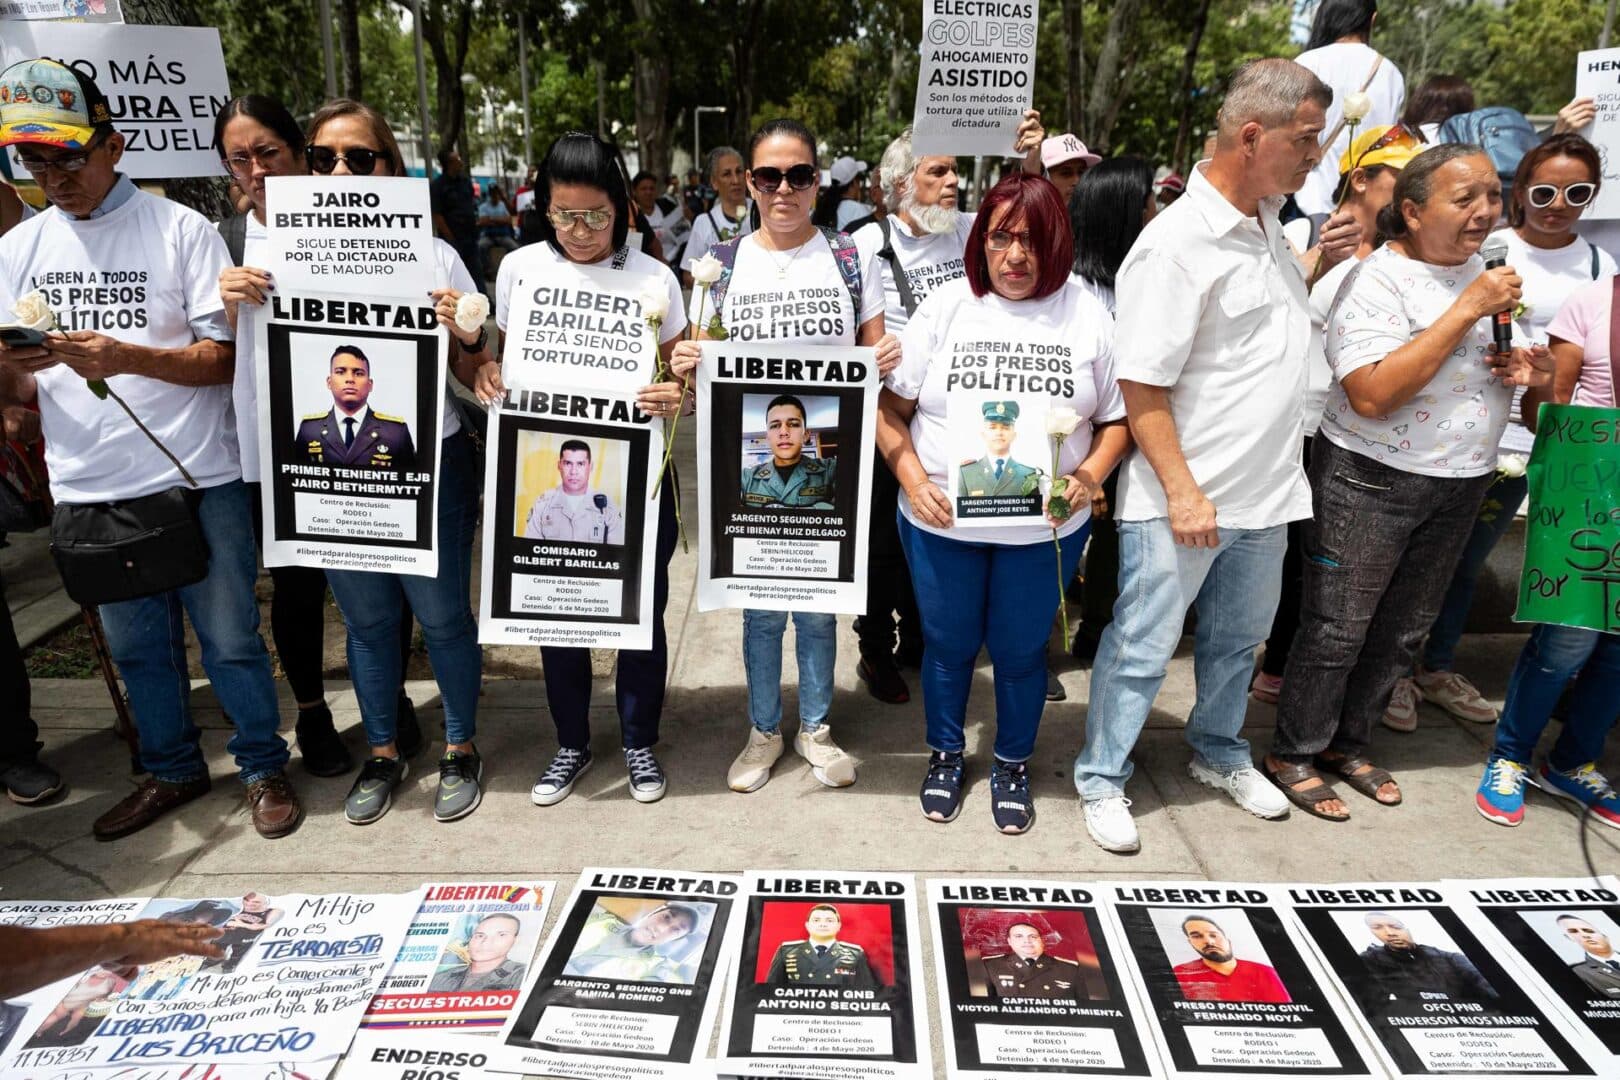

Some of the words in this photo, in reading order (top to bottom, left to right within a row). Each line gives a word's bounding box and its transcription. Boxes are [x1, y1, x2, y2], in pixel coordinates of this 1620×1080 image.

[927, 19, 1035, 48] GOLPES
[931, 50, 1029, 64] AHOGAMIENTO
[108, 54, 187, 85] MÁS
[928, 68, 1028, 88] ASISTIDO
[929, 92, 950, 102] Son
[952, 92, 967, 102] los
[970, 92, 1014, 104] métodos
[1016, 94, 1027, 103] de
[926, 106, 962, 116] tortura
[965, 108, 984, 120] que
[987, 106, 1018, 116] utiliza
[952, 119, 1000, 128] dictadura
[312, 192, 380, 208] JAIRO
[275, 212, 423, 229] BETHERMYTT
[296, 238, 337, 249] SIGUE
[340, 239, 411, 250] DETENIDO
[285, 252, 314, 262] POR
[317, 252, 334, 262] LA
[337, 252, 418, 263] DICTADURA
[88, 271, 97, 284] A
[101, 270, 148, 285] TODOS
[310, 264, 329, 275] DE
[332, 264, 394, 275] MADURO
[69, 286, 146, 306] PRESOS
[732, 292, 783, 306] LIBEREN
[787, 291, 796, 301] A
[798, 287, 840, 299] TODOS
[272, 296, 439, 331] LIBERTAD
[732, 306, 764, 323] LOS
[770, 300, 842, 320] PRESOS
[528, 310, 644, 339] BARILLAS
[730, 317, 844, 342] POLÍTICOS
[524, 329, 568, 345] ESTÁ
[573, 334, 643, 354] SIENDO
[954, 341, 1010, 354] LIBEREN
[1014, 342, 1024, 354] A
[1028, 344, 1072, 358] TODOS
[522, 347, 639, 372] TORTURADO
[951, 354, 988, 370] LOS
[994, 355, 1073, 375] PRESOS
[717, 356, 868, 383] LIBERTAD
[946, 369, 1075, 399] POLÍTICOS
[282, 464, 331, 477] PRIMER
[333, 468, 399, 482] TENIENTE
[406, 472, 432, 483] EJB
[292, 478, 330, 490] JAIRO
[334, 482, 422, 496] BETHERMYTT
[320, 498, 344, 507] Centro
[344, 499, 354, 507] de
[355, 500, 392, 510] Reclusión:
[996, 506, 1011, 514] JOSE
[312, 516, 331, 524] Caso:
[336, 518, 371, 527] Operación
[373, 520, 400, 529] Gedeon
[730, 514, 778, 523] SARGENTO
[779, 515, 822, 524] SEGUNDO
[824, 516, 844, 526] GNB
[346, 527, 356, 535] 10
[356, 528, 366, 536] de
[366, 529, 386, 538] Mayo
[386, 530, 404, 538] 2020
[724, 526, 745, 535] JOSE
[746, 526, 782, 535] IBIENAY
[782, 527, 803, 536] RUIZ
[804, 528, 847, 537] DELGADO
[532, 546, 598, 557] COMISARIO
[321, 558, 392, 569] #operaciongedeon
[513, 555, 562, 568] GILBERT
[564, 558, 620, 570] BARILLAS
[532, 578, 556, 586] Centro
[558, 578, 566, 586] de
[567, 578, 601, 586] Reclusión:
[590, 873, 739, 896] LIBERTAD
[756, 878, 906, 896] LIBERTAD
[941, 885, 1094, 904] LIBERTAD
[1114, 887, 1269, 905] LIBERTAD
[1287, 888, 1444, 904] LIBERTAD
[1468, 889, 1620, 904] LIBERTAD
[0, 905, 62, 914] CARLOS
[63, 902, 139, 914] SÁNCHEZ
[295, 897, 331, 918] Mi
[328, 896, 375, 925] Hijo
[274, 926, 299, 937] no
[303, 922, 327, 934] es
[260, 934, 384, 960] TERRORISTA
[191, 975, 212, 994] Mi
[214, 975, 248, 998] hijo
[252, 969, 275, 982] es
[276, 963, 366, 981] Comerciante
[368, 962, 385, 976] ya
[553, 979, 611, 990] SARGENTO
[615, 984, 667, 995] SEGUNDO
[669, 988, 694, 996] GNB
[618, 993, 665, 1003] ROMERO
[774, 988, 839, 998] CAPITAN
[842, 989, 875, 1000] GNB
[1002, 997, 1050, 1006] CAPITAN
[1054, 998, 1077, 1006] GNB
[116, 1000, 146, 1014] Con
[371, 995, 514, 1011] SECUESTRADO
[757, 1000, 826, 1009] ANTONIO
[830, 1001, 891, 1011] SEQUEA
[956, 1004, 999, 1012] VICTOR
[1001, 1006, 1068, 1015] ALEJANDRO
[1069, 1008, 1124, 1018] PIMIENTA
[1173, 1002, 1216, 1010] PRESO
[1218, 1002, 1277, 1012] POLÍTICO
[1279, 1004, 1314, 1012] CIVIL
[1456, 1003, 1484, 1012] PNB
[94, 1012, 207, 1037] LIBERTAD
[206, 1012, 247, 1030] para
[250, 1003, 271, 1018] mi
[313, 998, 329, 1015] Ya
[1194, 1012, 1263, 1022] FERNANDO
[1266, 1013, 1303, 1022] NOYA
[1386, 1016, 1459, 1026] ENDERSON
[1460, 1016, 1492, 1026] RIOS
[1495, 1016, 1540, 1026] MARIN
[176, 1026, 317, 1058] BRICEÑO
[370, 1048, 488, 1068] ENDERSO
